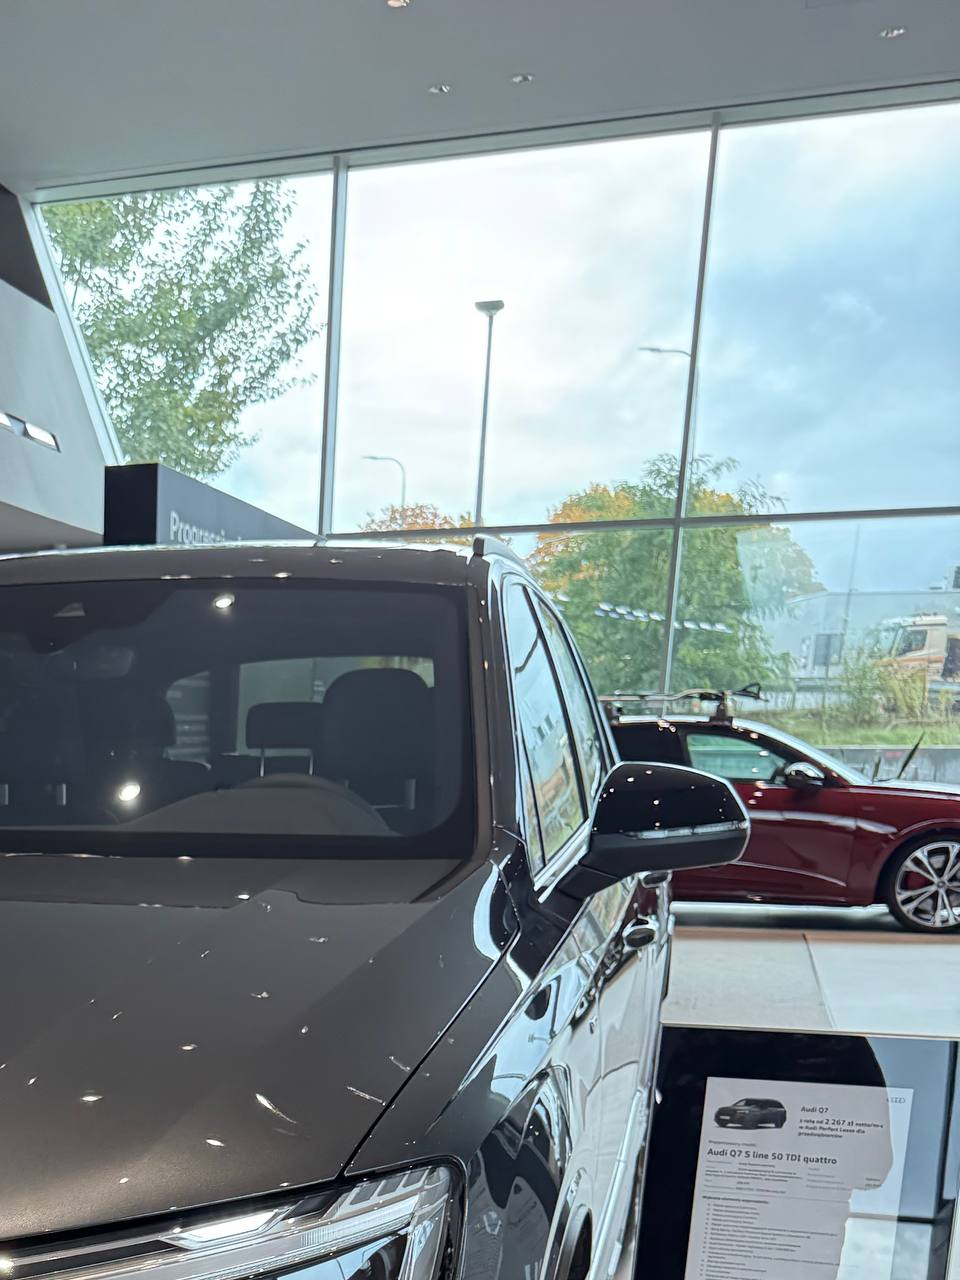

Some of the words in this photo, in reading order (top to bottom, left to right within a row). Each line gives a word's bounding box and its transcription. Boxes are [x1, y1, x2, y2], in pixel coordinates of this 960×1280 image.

[831, 1118, 846, 1126] 267
[707, 1148, 727, 1156] Audi
[729, 1149, 743, 1158] Q7
[744, 1150, 751, 1158] S
[752, 1151, 769, 1160] line
[771, 1152, 783, 1160] 50
[786, 1153, 801, 1162] TDI
[803, 1155, 837, 1164] quattro
